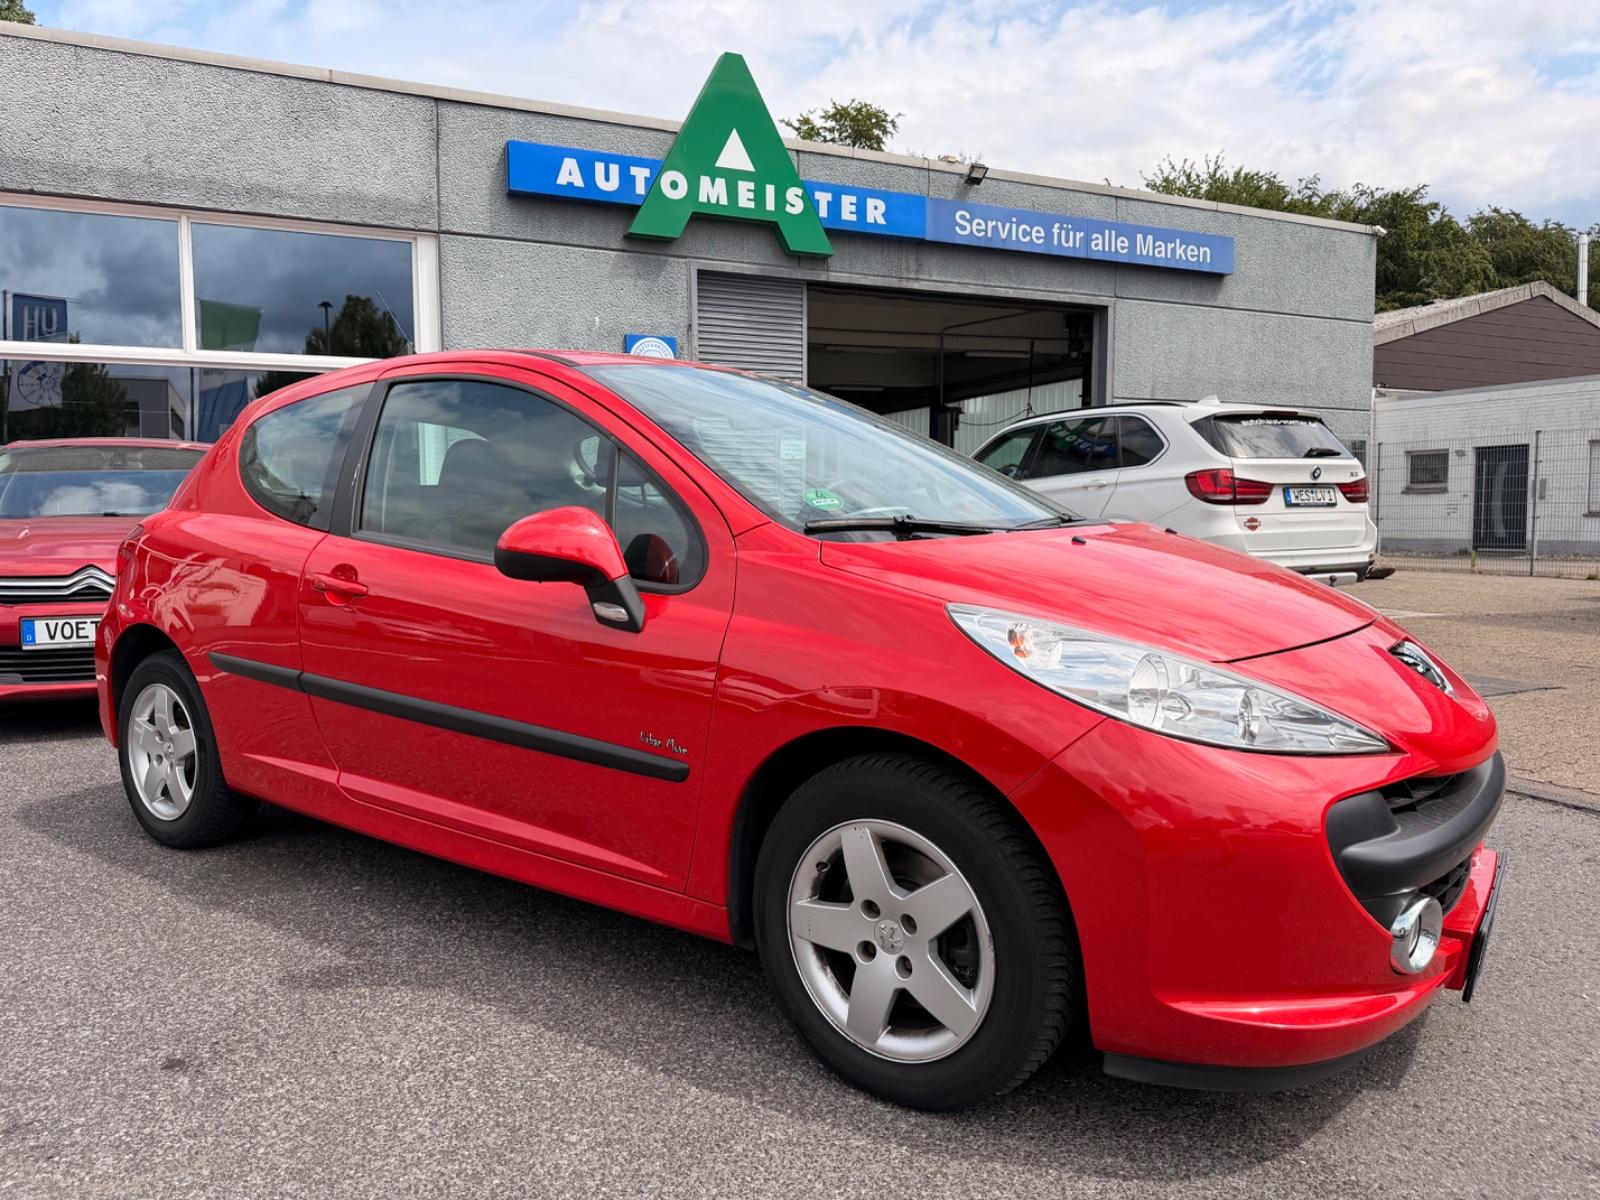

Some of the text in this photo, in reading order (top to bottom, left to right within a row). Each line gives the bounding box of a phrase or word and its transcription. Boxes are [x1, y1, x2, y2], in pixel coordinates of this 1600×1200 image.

[556, 157, 887, 225] AUTOMEISTER
[954, 210, 1211, 264] Service für alle Marken
